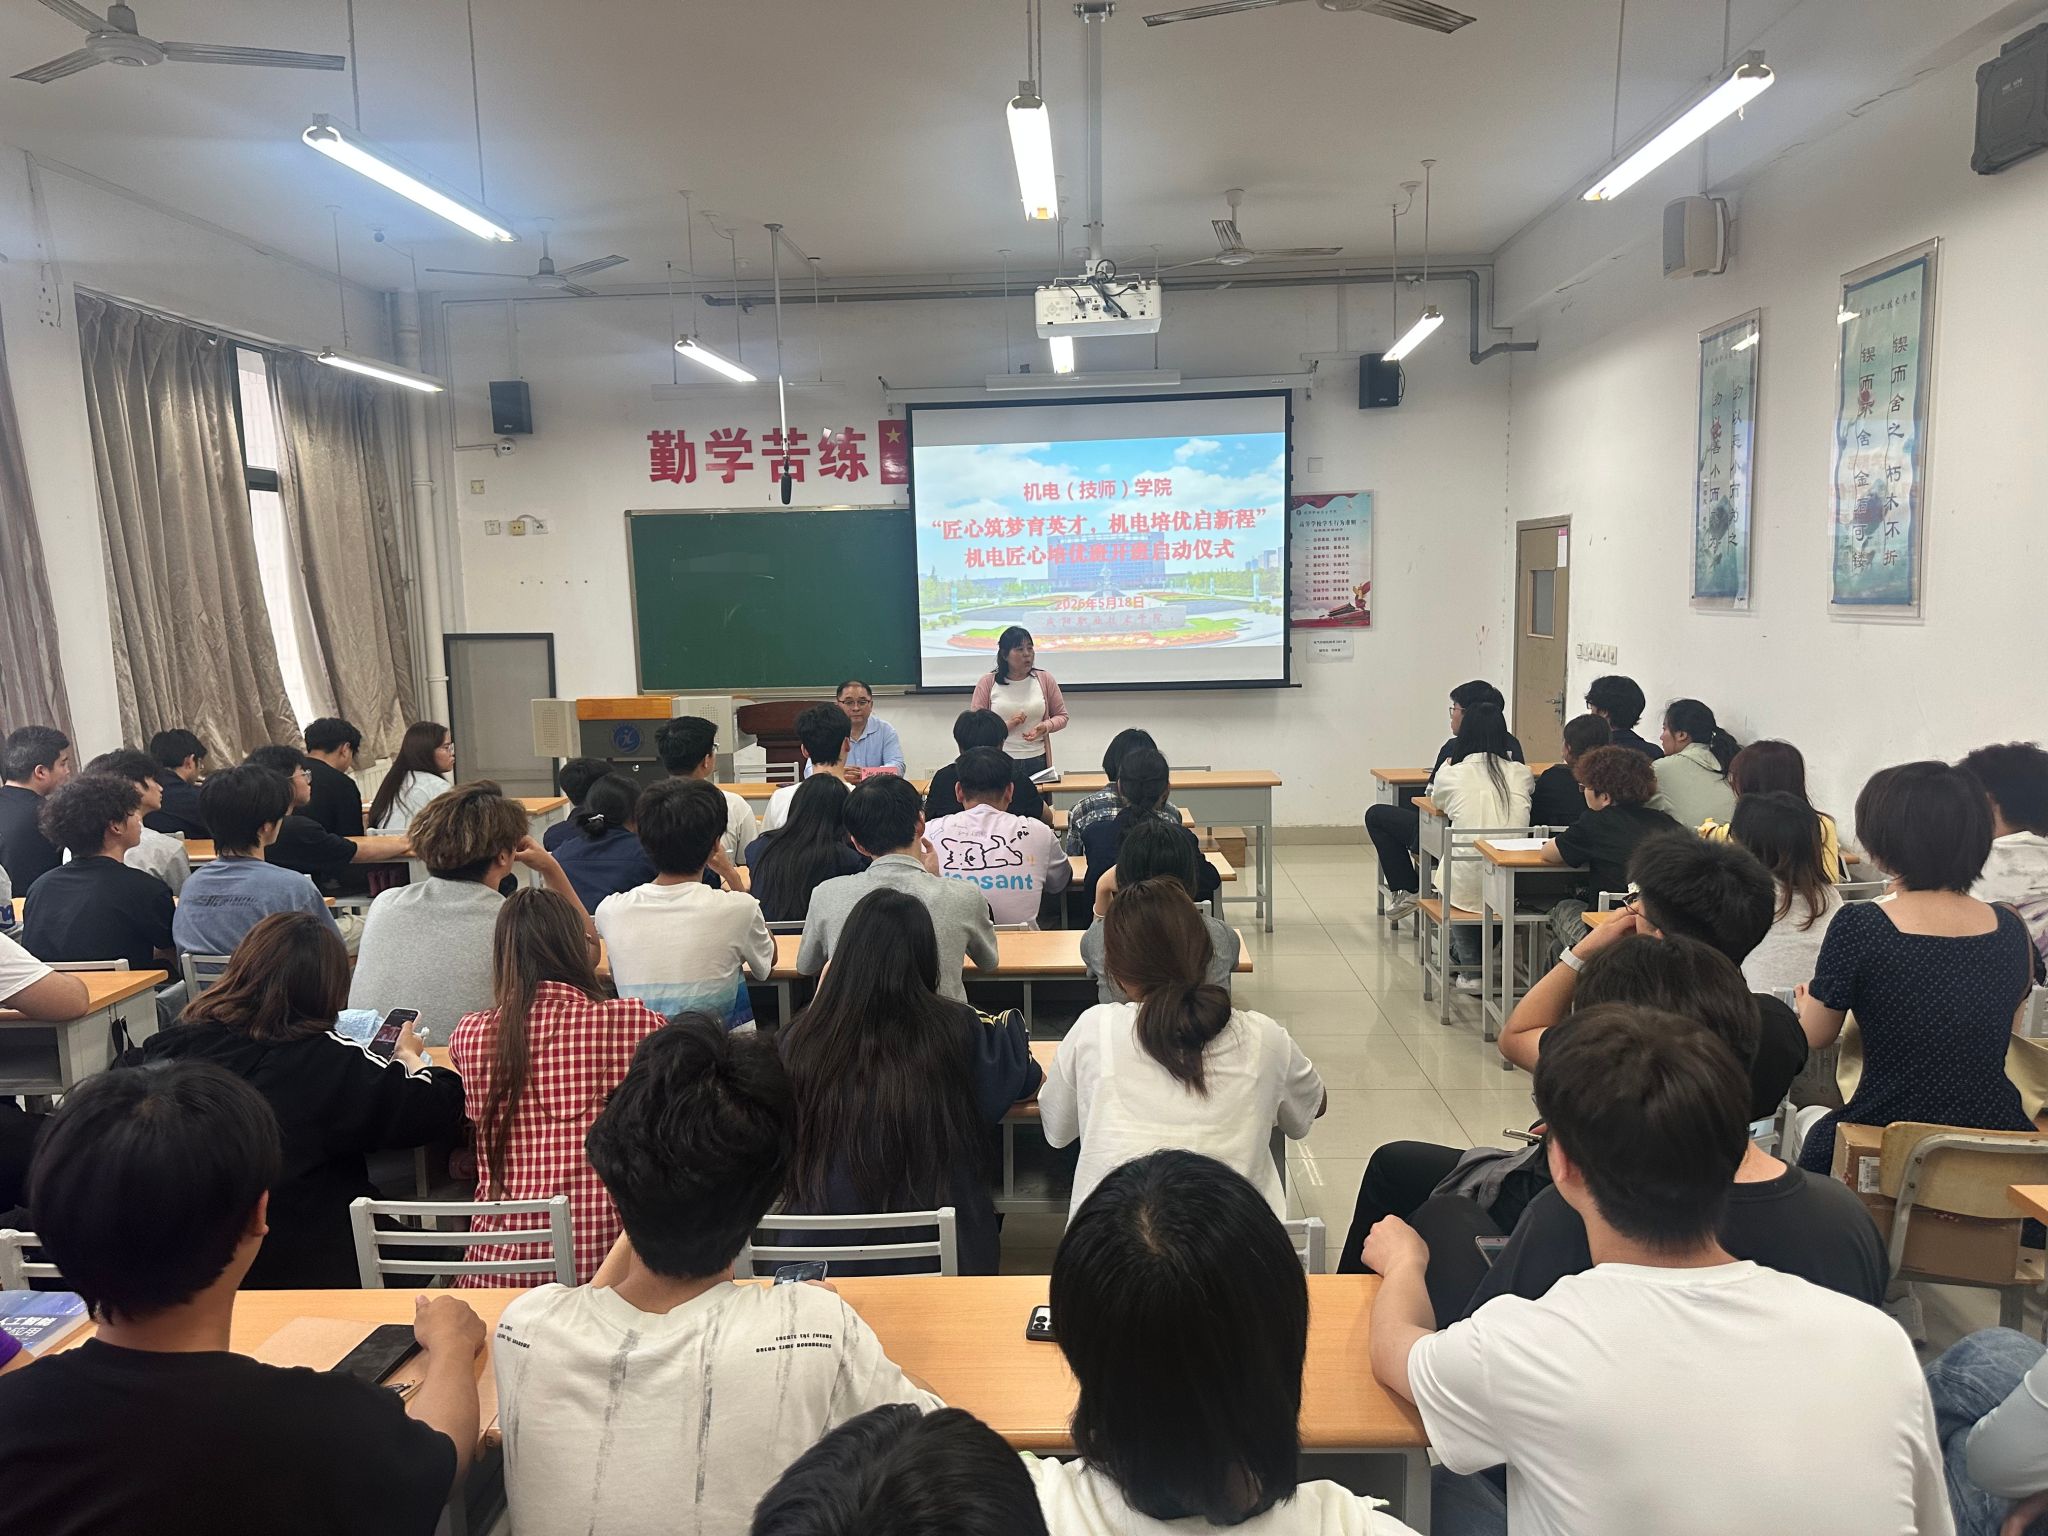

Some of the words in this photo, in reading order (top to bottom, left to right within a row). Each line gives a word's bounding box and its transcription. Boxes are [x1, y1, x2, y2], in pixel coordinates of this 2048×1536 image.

[647, 426, 869, 484] 勤学苦练
[1883, 336, 1908, 566] 锲而舍之朽木不折
[1023, 478, 1173, 501] 机电（技师）学院
[964, 538, 1236, 568] 机电匠心培优班开班启动仪式
